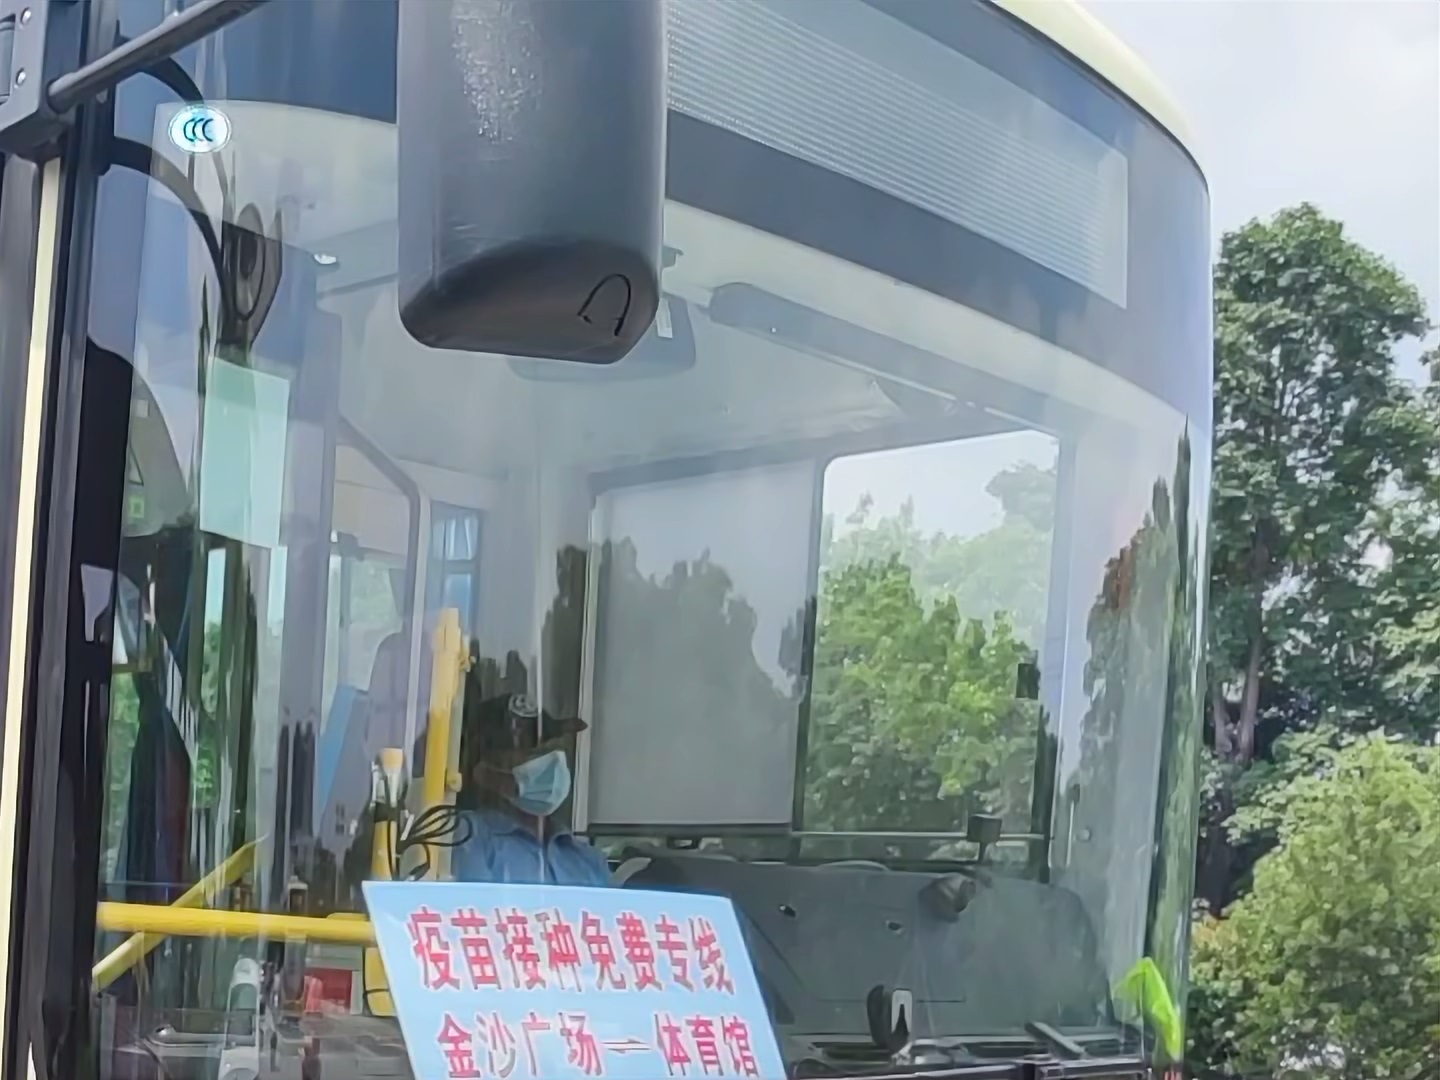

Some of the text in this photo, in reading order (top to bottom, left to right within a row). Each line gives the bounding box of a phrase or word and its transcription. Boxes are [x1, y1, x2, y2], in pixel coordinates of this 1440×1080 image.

[406, 904, 736, 995] 疫苗接种免费专线
[436, 1010, 761, 1079] 金沙广场 体育馆
